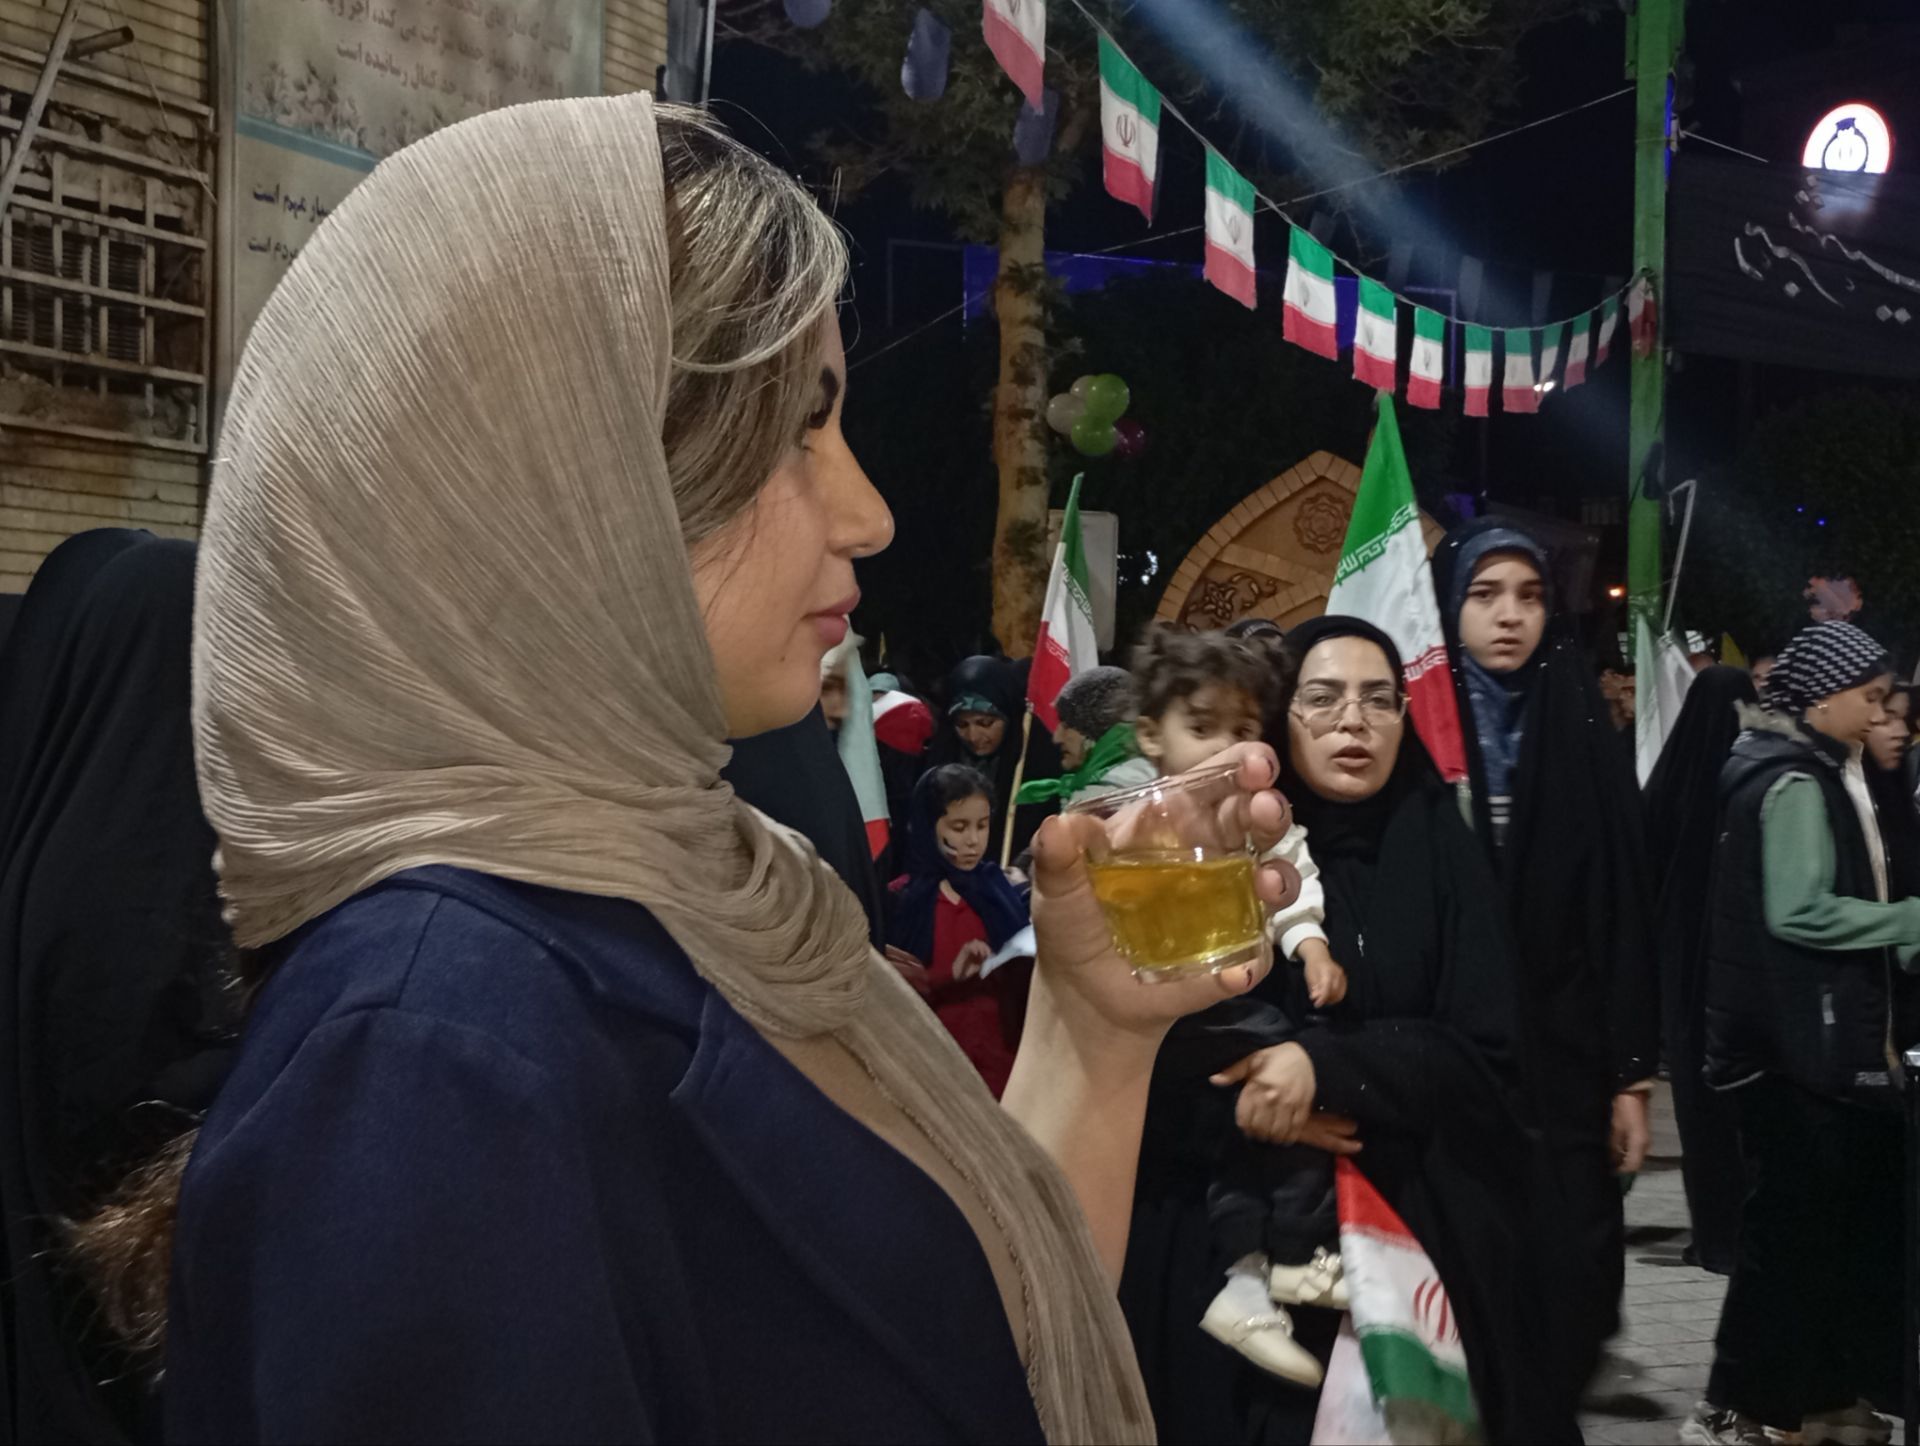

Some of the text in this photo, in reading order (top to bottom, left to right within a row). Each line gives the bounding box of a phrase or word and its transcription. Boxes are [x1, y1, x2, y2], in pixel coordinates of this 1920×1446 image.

[337, 39, 362, 62] است
[253, 183, 280, 205] است
[248, 236, 271, 254] است
